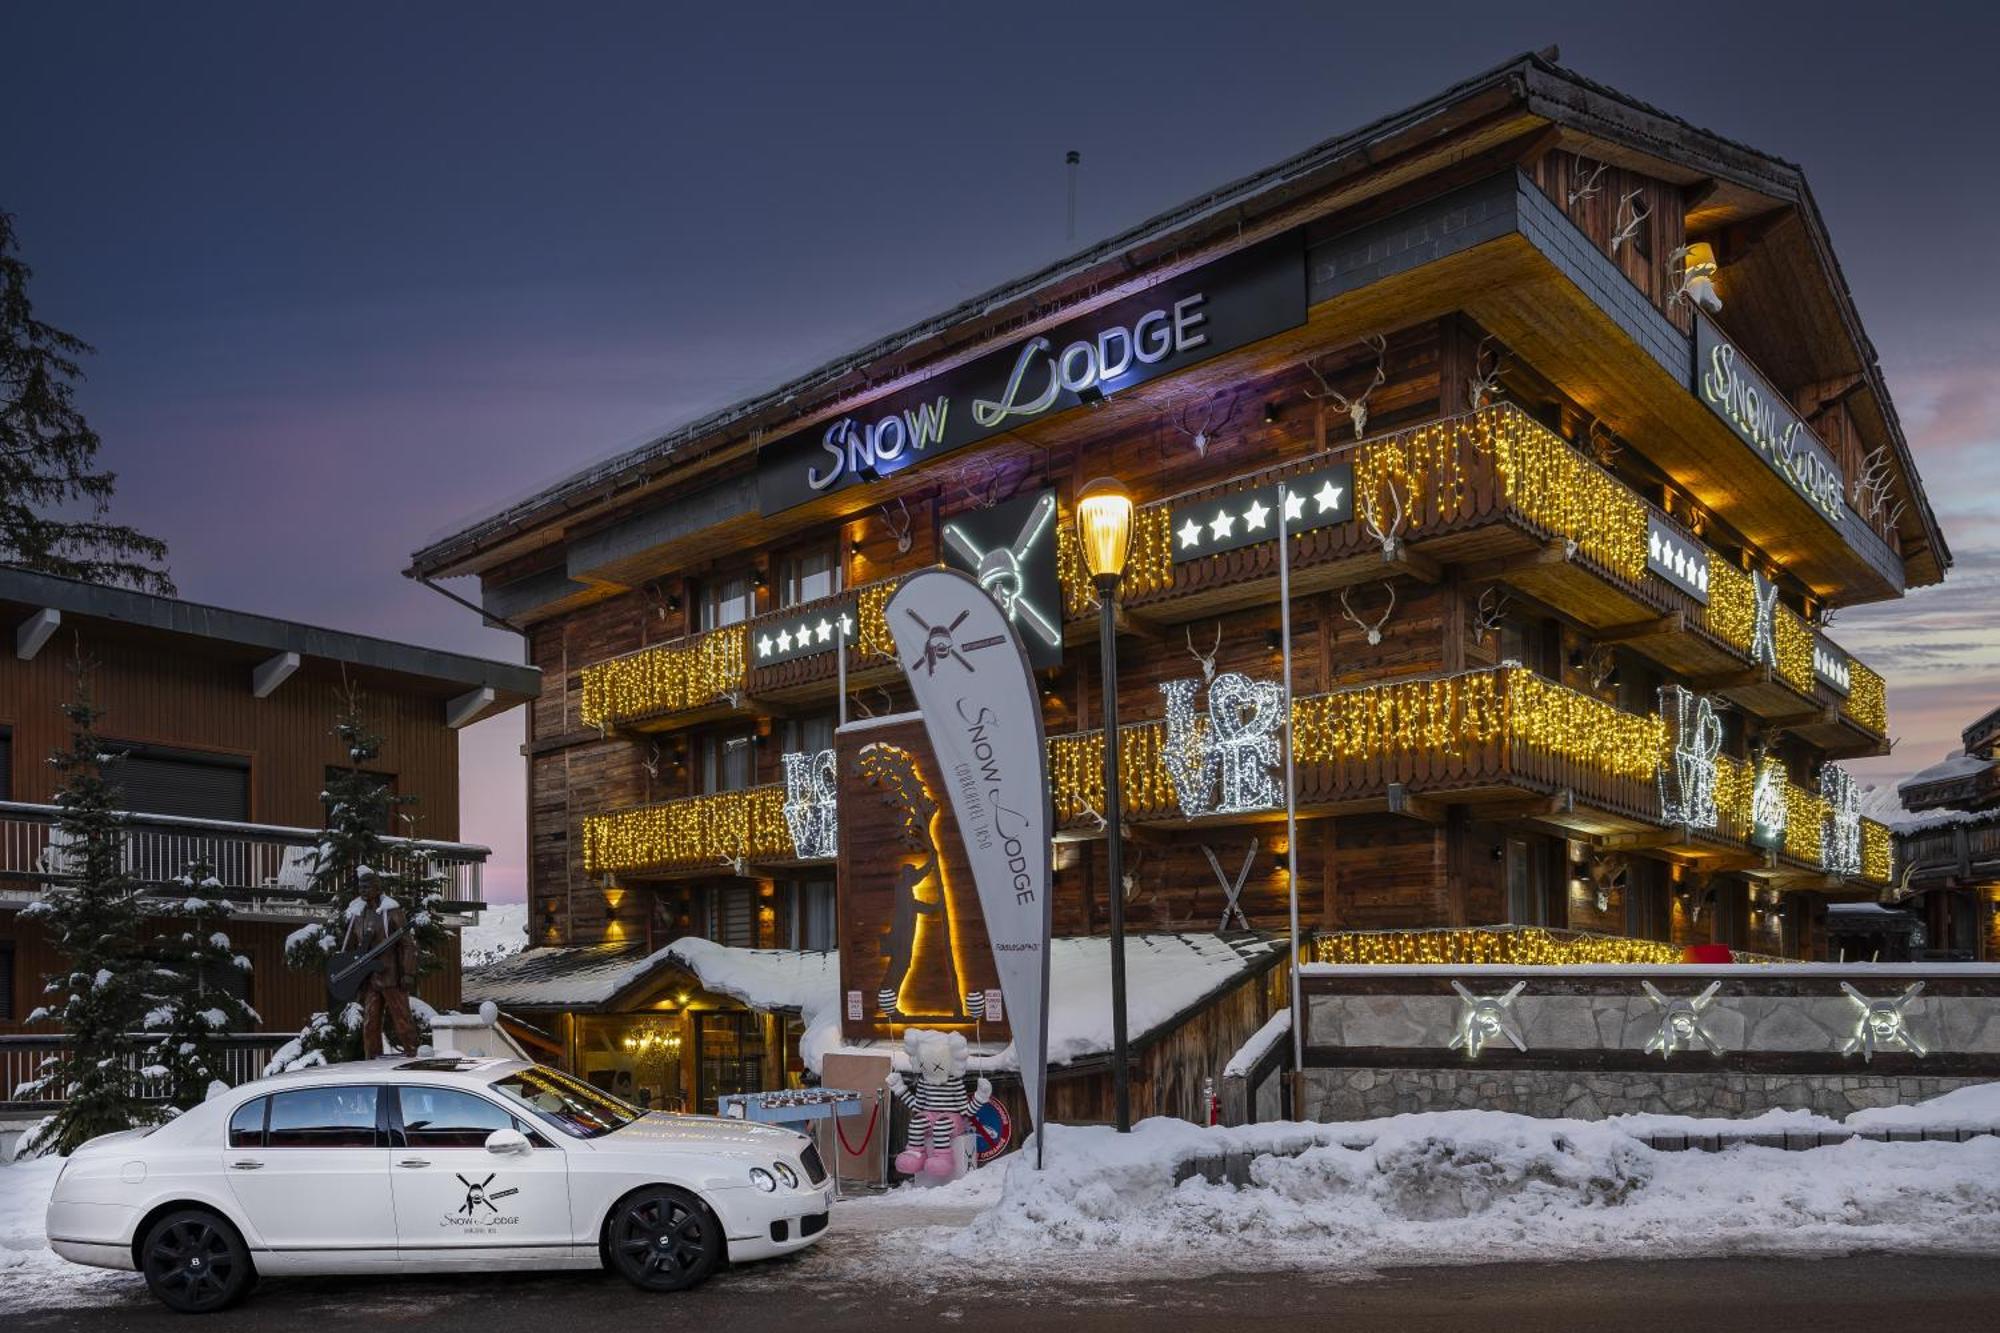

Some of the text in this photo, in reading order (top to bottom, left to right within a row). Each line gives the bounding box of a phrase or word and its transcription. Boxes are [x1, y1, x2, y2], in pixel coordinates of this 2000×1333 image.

[808, 292, 1208, 491] SNOW LODGE
[1704, 343, 1845, 521] SNOW LODGE
[957, 697, 1002, 781] SNOW
[988, 788, 1035, 905] LODGE
